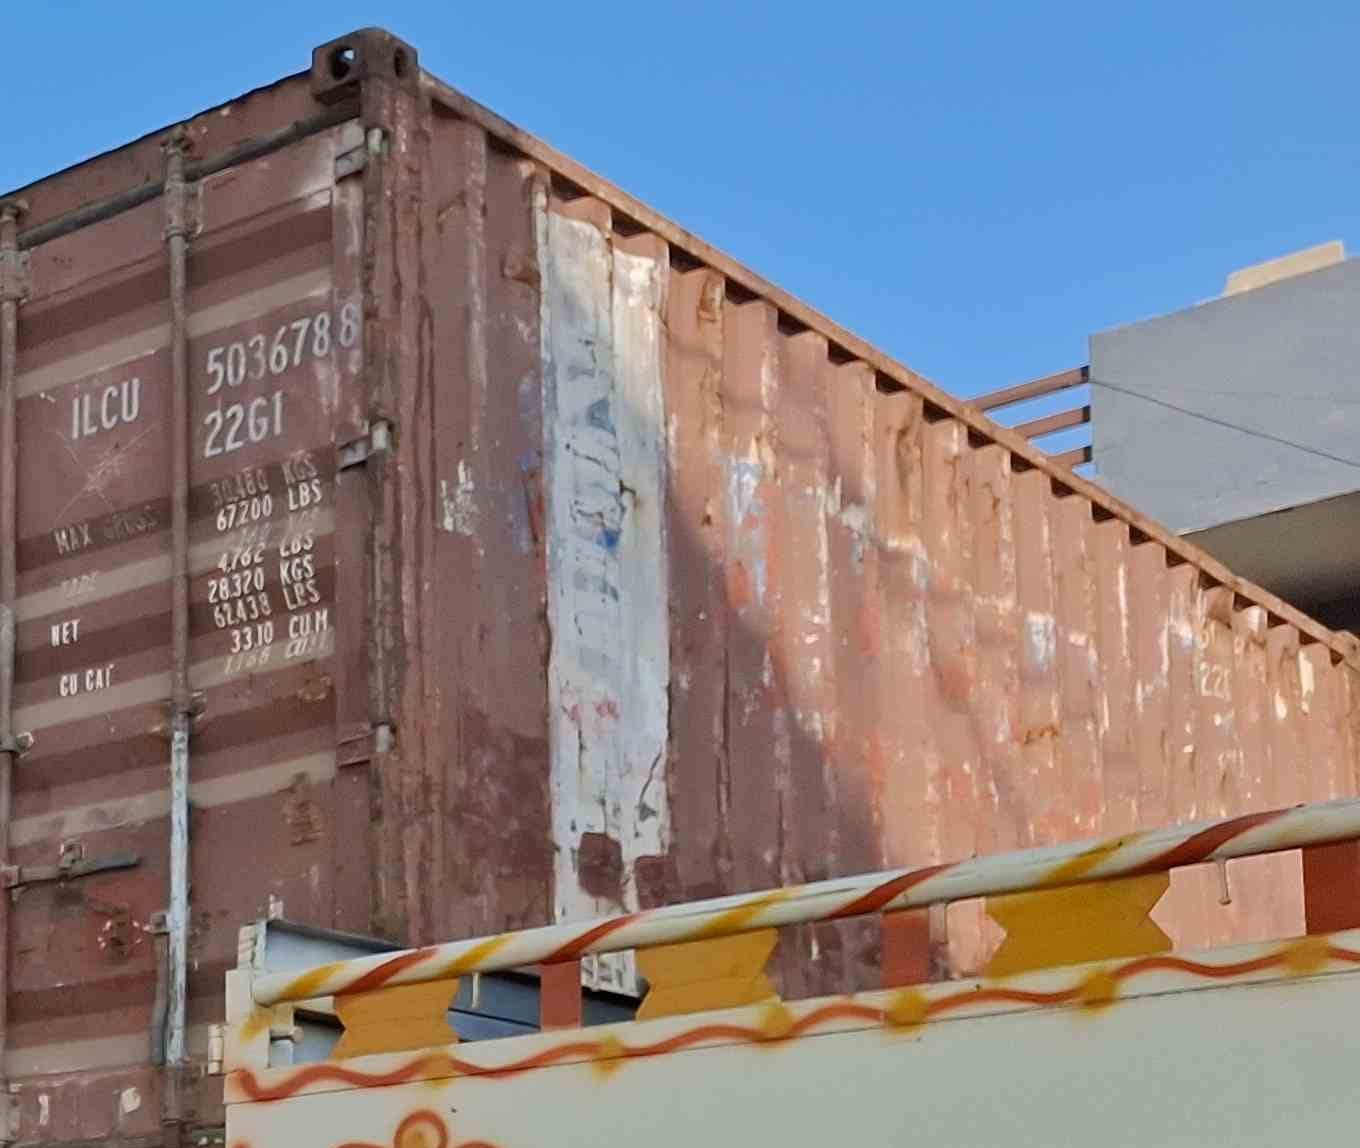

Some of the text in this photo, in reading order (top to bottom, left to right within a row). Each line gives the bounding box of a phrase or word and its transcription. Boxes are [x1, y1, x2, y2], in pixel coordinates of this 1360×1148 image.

[71, 378, 141, 441] ILCU
[203, 390, 285, 458] 22G1
[287, 478, 322, 511] LBS
[52, 523, 94, 555] MAX
[50, 618, 81, 647] NET
[279, 553, 315, 586] KGS
